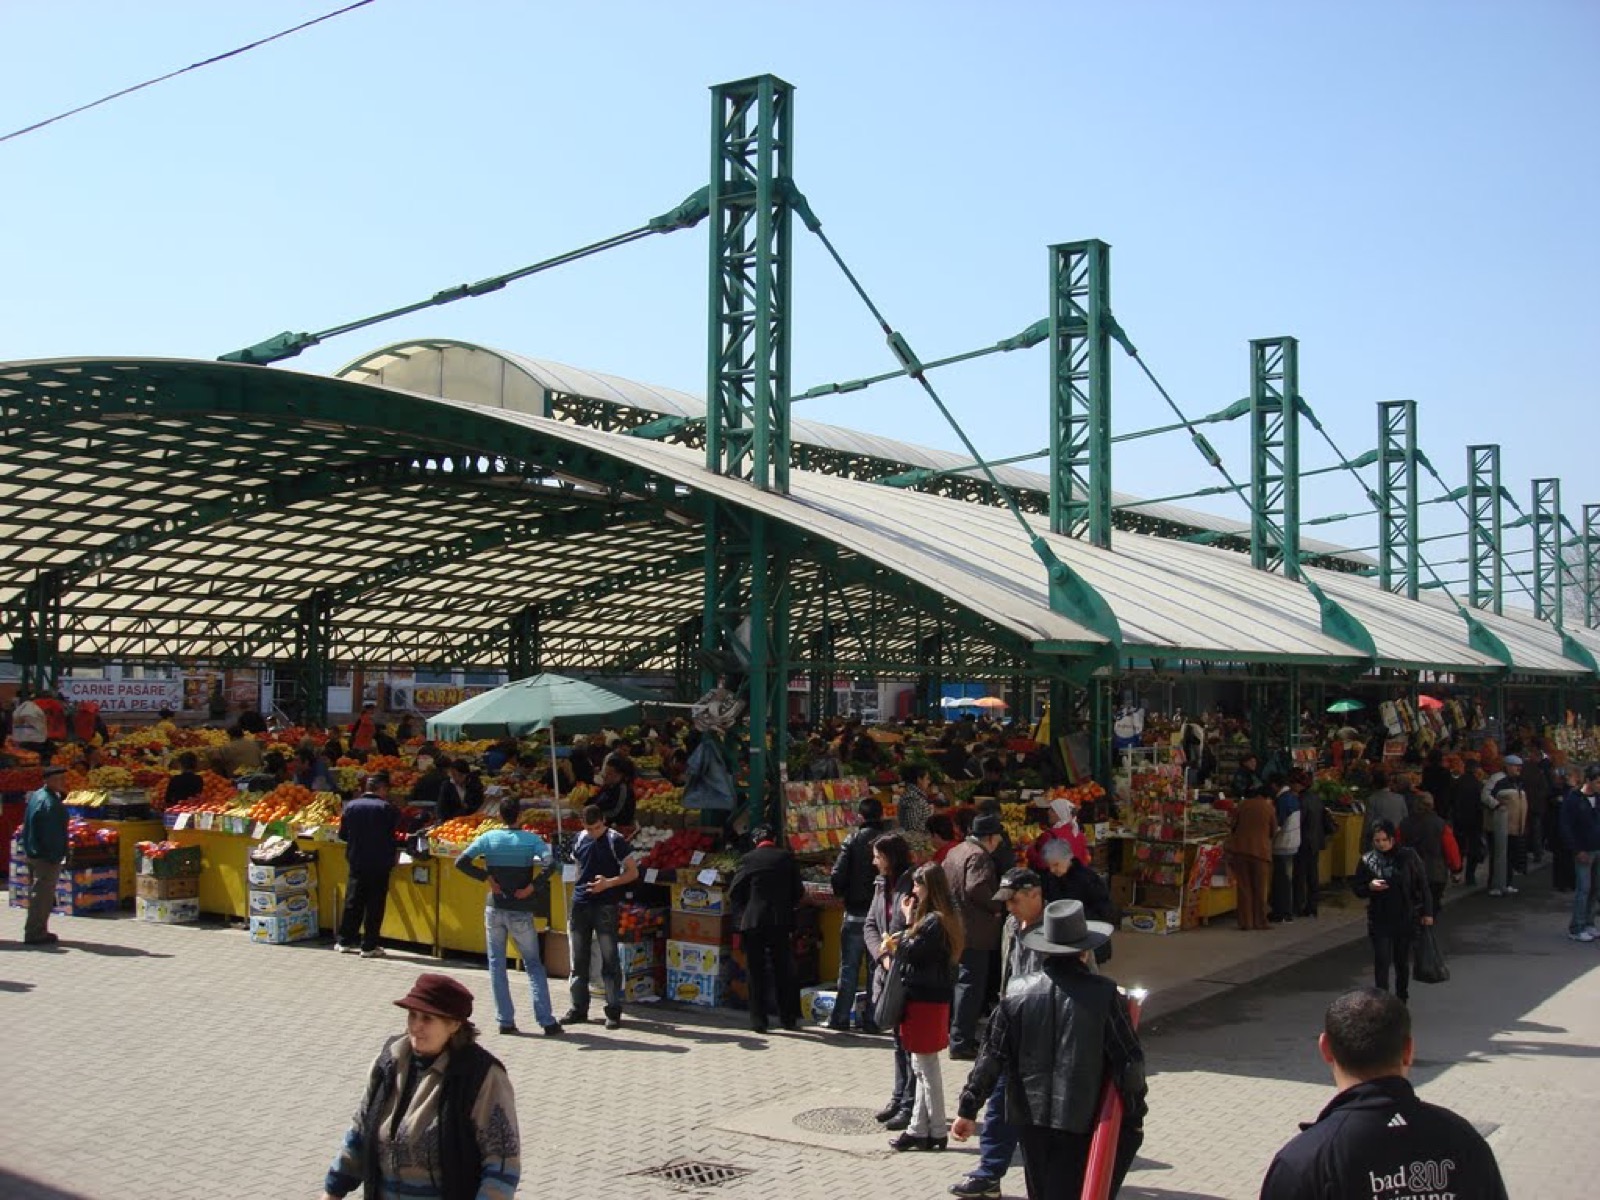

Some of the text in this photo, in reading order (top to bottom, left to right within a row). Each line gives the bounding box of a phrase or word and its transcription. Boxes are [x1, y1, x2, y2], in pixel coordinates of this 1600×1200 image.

[72, 684, 115, 695] CARNE
[131, 699, 148, 709] PE
[1369, 1165, 1407, 1192] bad
